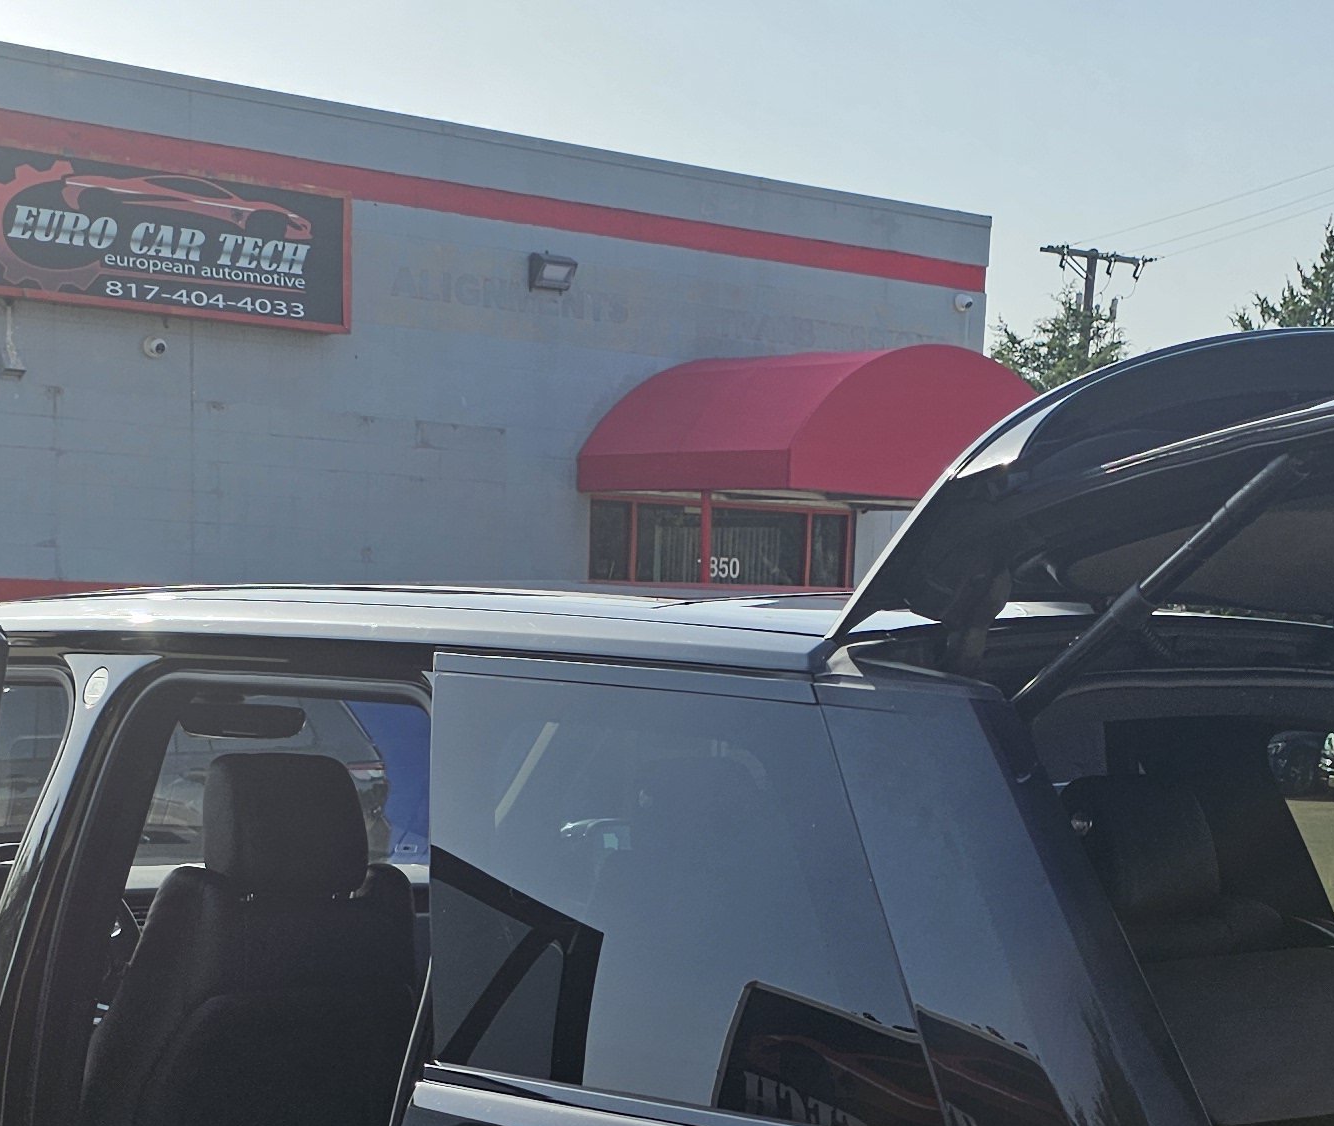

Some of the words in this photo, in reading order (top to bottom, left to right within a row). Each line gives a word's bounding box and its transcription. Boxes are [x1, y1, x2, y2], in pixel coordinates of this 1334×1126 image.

[7, 204, 118, 250] EURO
[129, 221, 207, 262] CAR
[217, 233, 312, 275] TECH
[104, 252, 196, 276] european
[201, 263, 306, 289] automotive
[105, 280, 306, 318] 817-404-4033
[698, 556, 740, 579] 850
